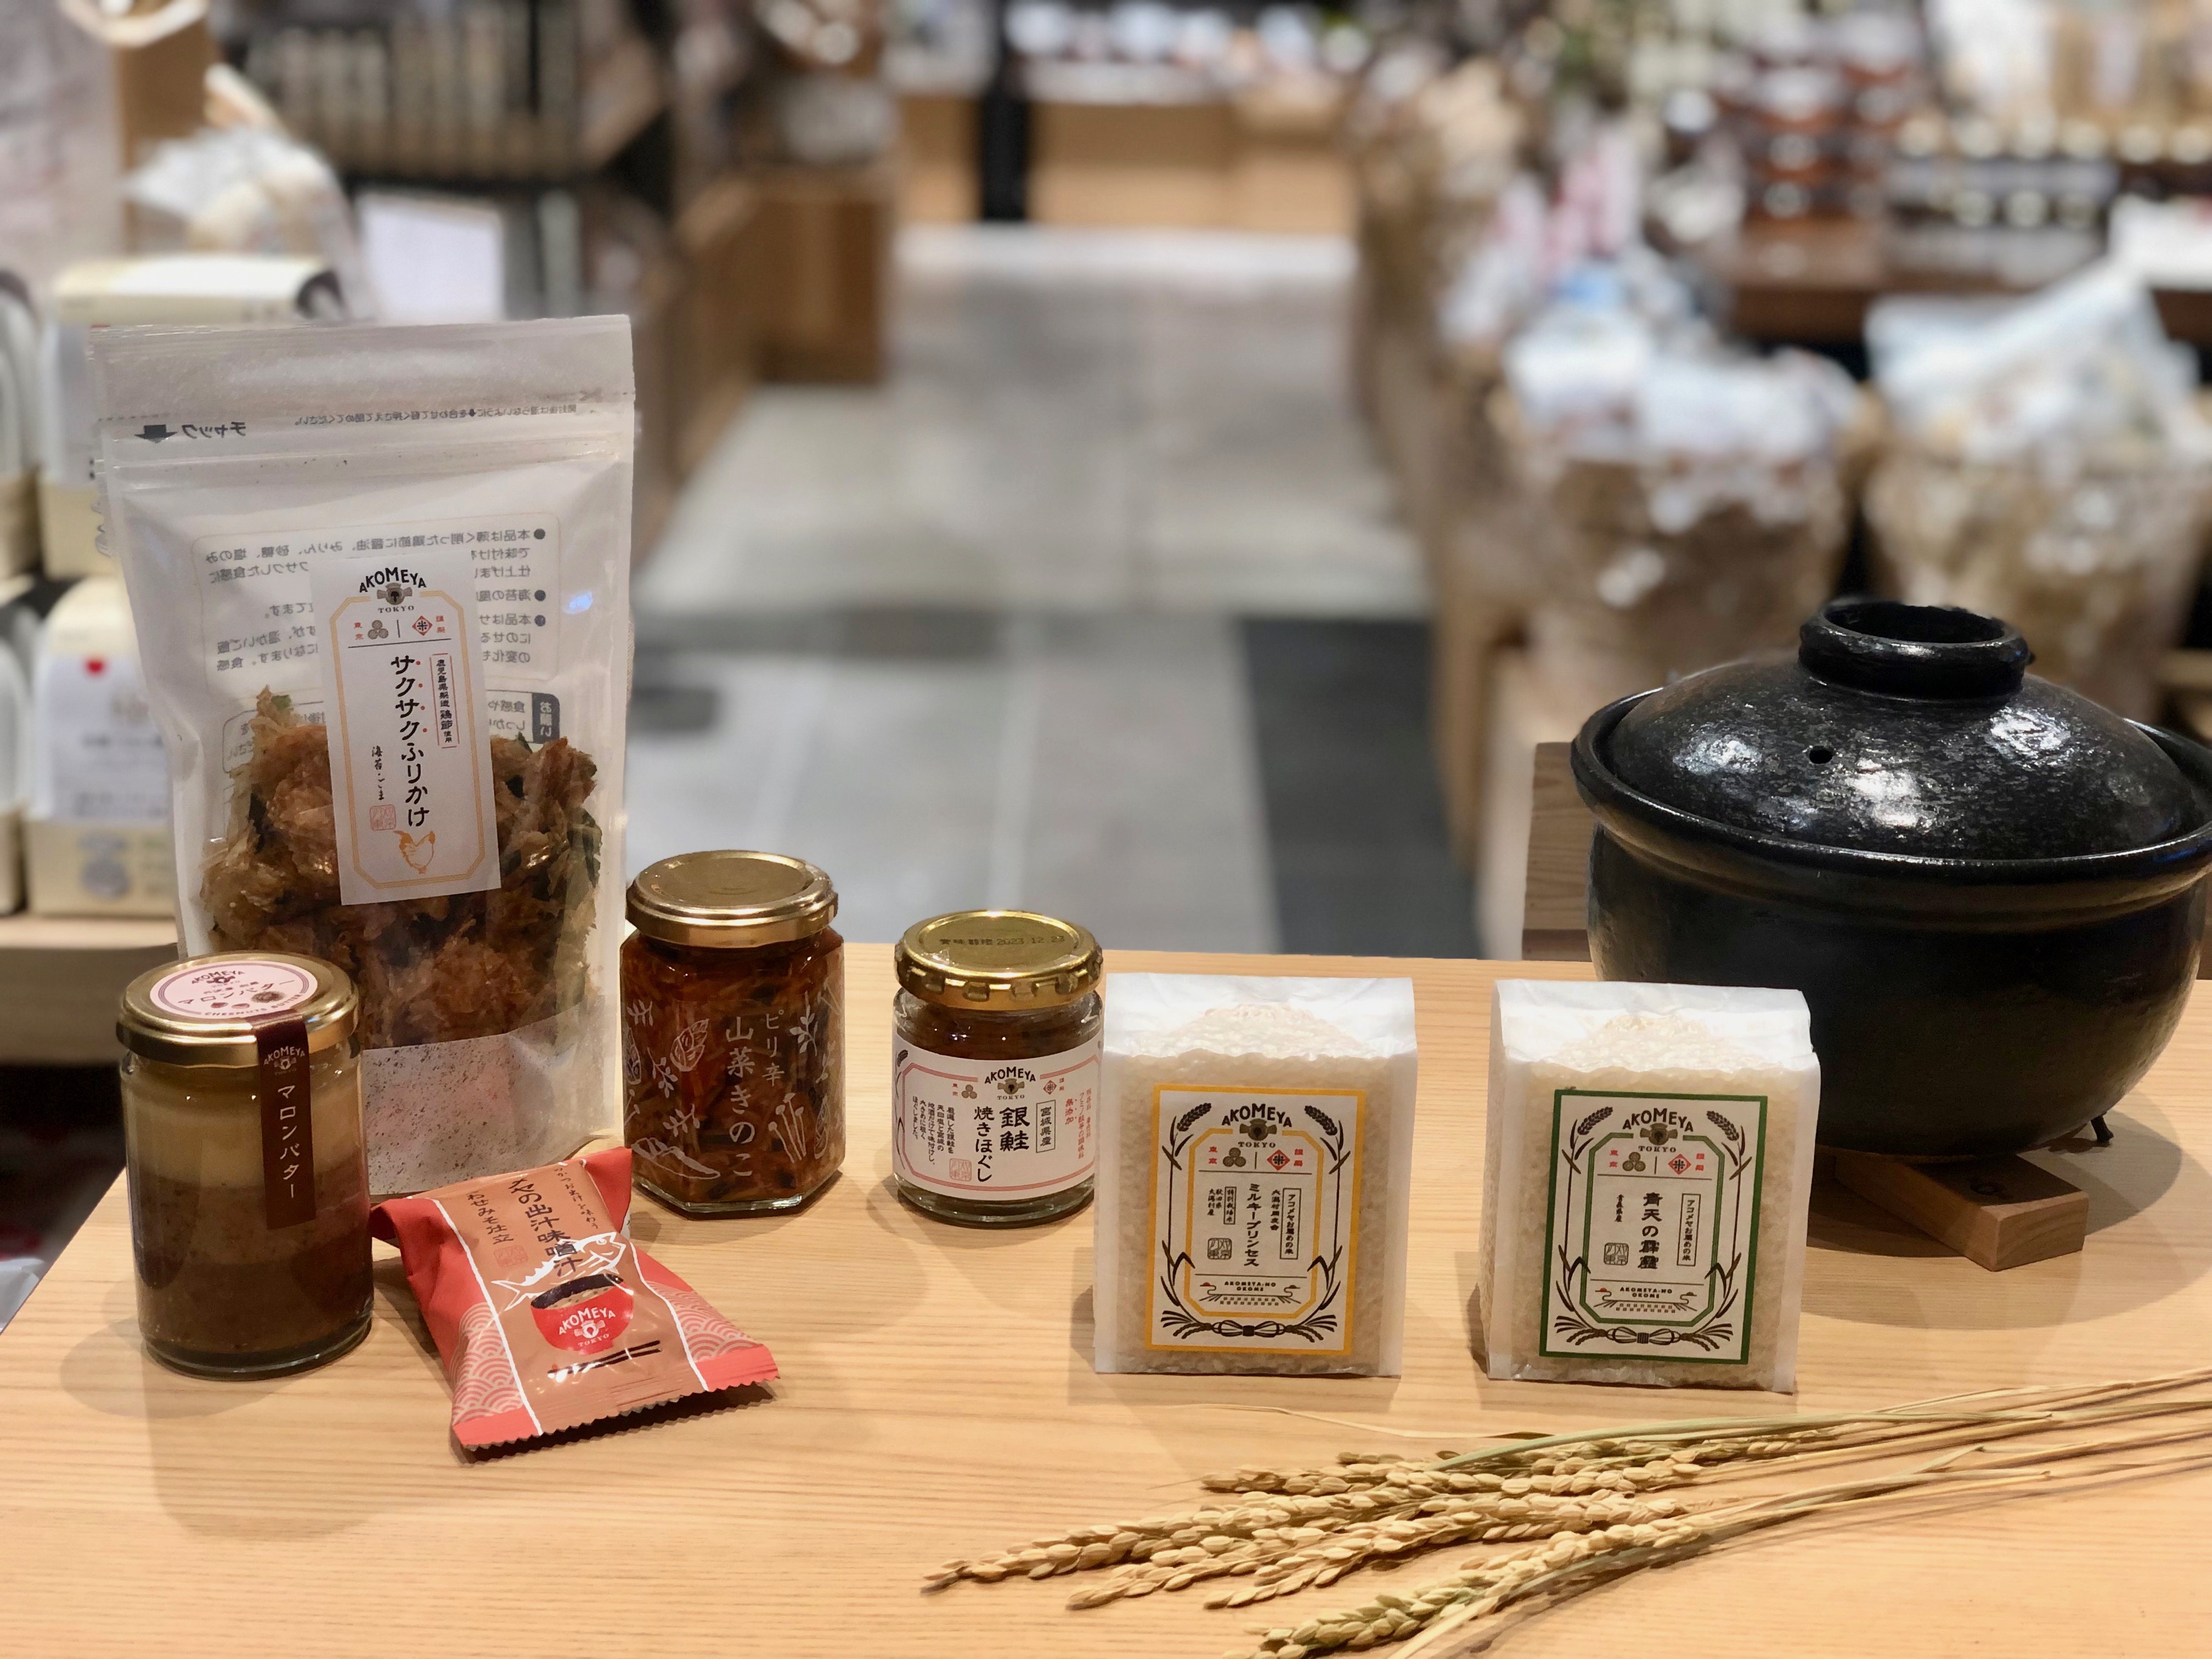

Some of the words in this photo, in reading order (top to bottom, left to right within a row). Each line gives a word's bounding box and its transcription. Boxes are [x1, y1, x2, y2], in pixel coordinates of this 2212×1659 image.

[359, 567, 427, 592] AKOMEYA
[377, 605, 415, 613] TOKYO
[391, 655, 430, 827] サクサクふりかけ
[191, 970, 245, 984] AKOMEYA
[178, 980, 295, 1005] マロンバター
[263, 1045, 305, 1065] AKOMEYA
[762, 1009, 785, 1087] ピリ辛
[984, 1066, 1036, 1084] AKOMEYA
[725, 1016, 755, 1177] 山菜きのこ
[1040, 1106, 1052, 1147] 宮城県産
[1222, 1103, 1292, 1127] AKOMEYA
[1622, 1108, 1694, 1132] AKOMEYA
[998, 1105, 1030, 1152] 銀鮭
[278, 1085, 300, 1199] マロンバター
[973, 1105, 995, 1182] 焼きほぐし
[1244, 1183, 1261, 1267] ミルキープリンセス
[558, 1307, 616, 1335] AKOMEYA
[578, 1333, 610, 1347] TOKYO
